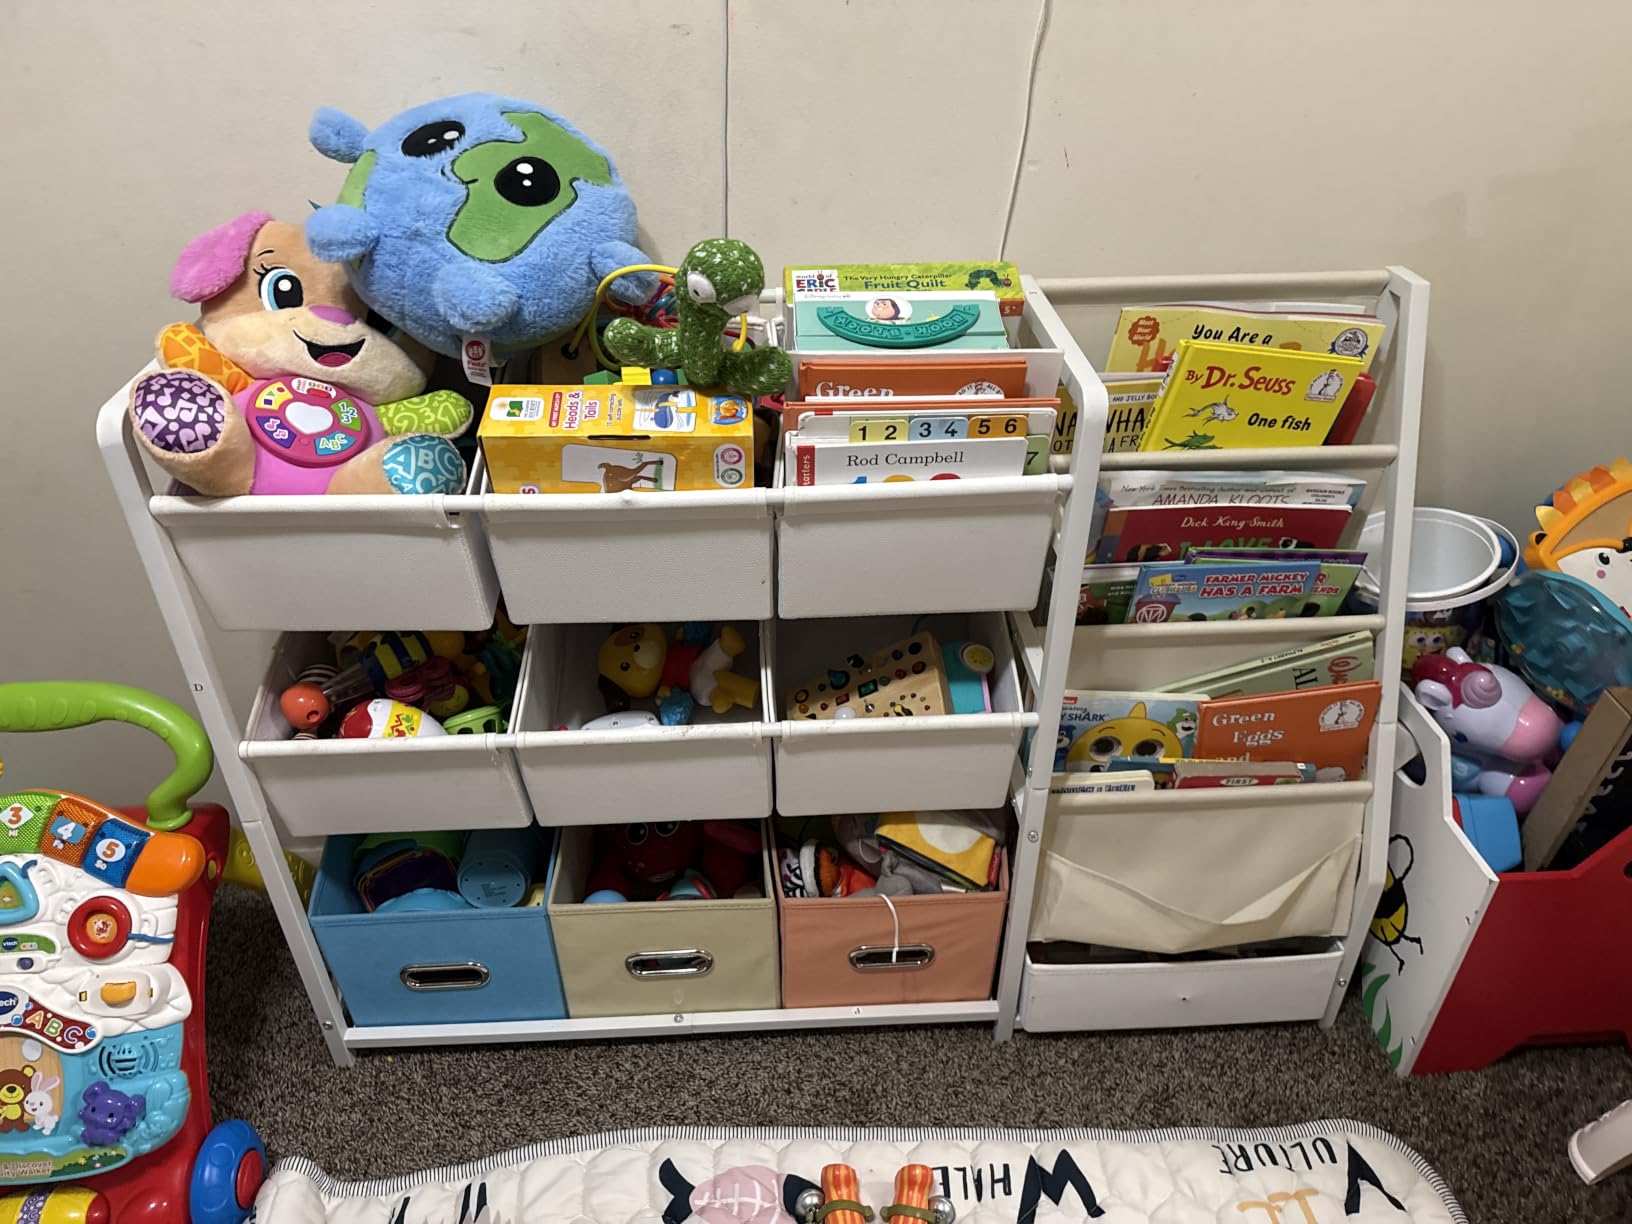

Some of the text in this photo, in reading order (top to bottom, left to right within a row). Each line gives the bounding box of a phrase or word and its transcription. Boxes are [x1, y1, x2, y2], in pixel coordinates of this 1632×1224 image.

[796, 279, 836, 288] ERIC
[864, 280, 946, 289] Fruit Quilt
[1191, 324, 1273, 346] You Are a
[1185, 370, 1203, 385] By
[1200, 365, 1236, 390] Dr.
[1240, 366, 1297, 396] Seuss
[564, 401, 579, 429] Heads
[584, 401, 598, 419] Tails
[859, 418, 1018, 441] 1 2 3 4 5 6
[1247, 413, 1311, 431] One fish
[319, 433, 348, 450] ABC
[847, 452, 965, 468] Rod Campbell
[1027, 452, 1040, 466] 7
[1152, 493, 1219, 505] AMANDA
[1180, 517, 1209, 528] Dick
[1204, 571, 1310, 585] FARMER MICKEY
[1199, 585, 1238, 597] HAS
[1239, 585, 1254, 596] A
[1257, 584, 1304, 596] FARM
[1067, 712, 1106, 722] SHARK
[1212, 712, 1276, 727] Green
[1233, 729, 1285, 748] Eggs
[1225, 777, 1253, 785] FIRST
[8, 806, 120, 859] 3 4 5
